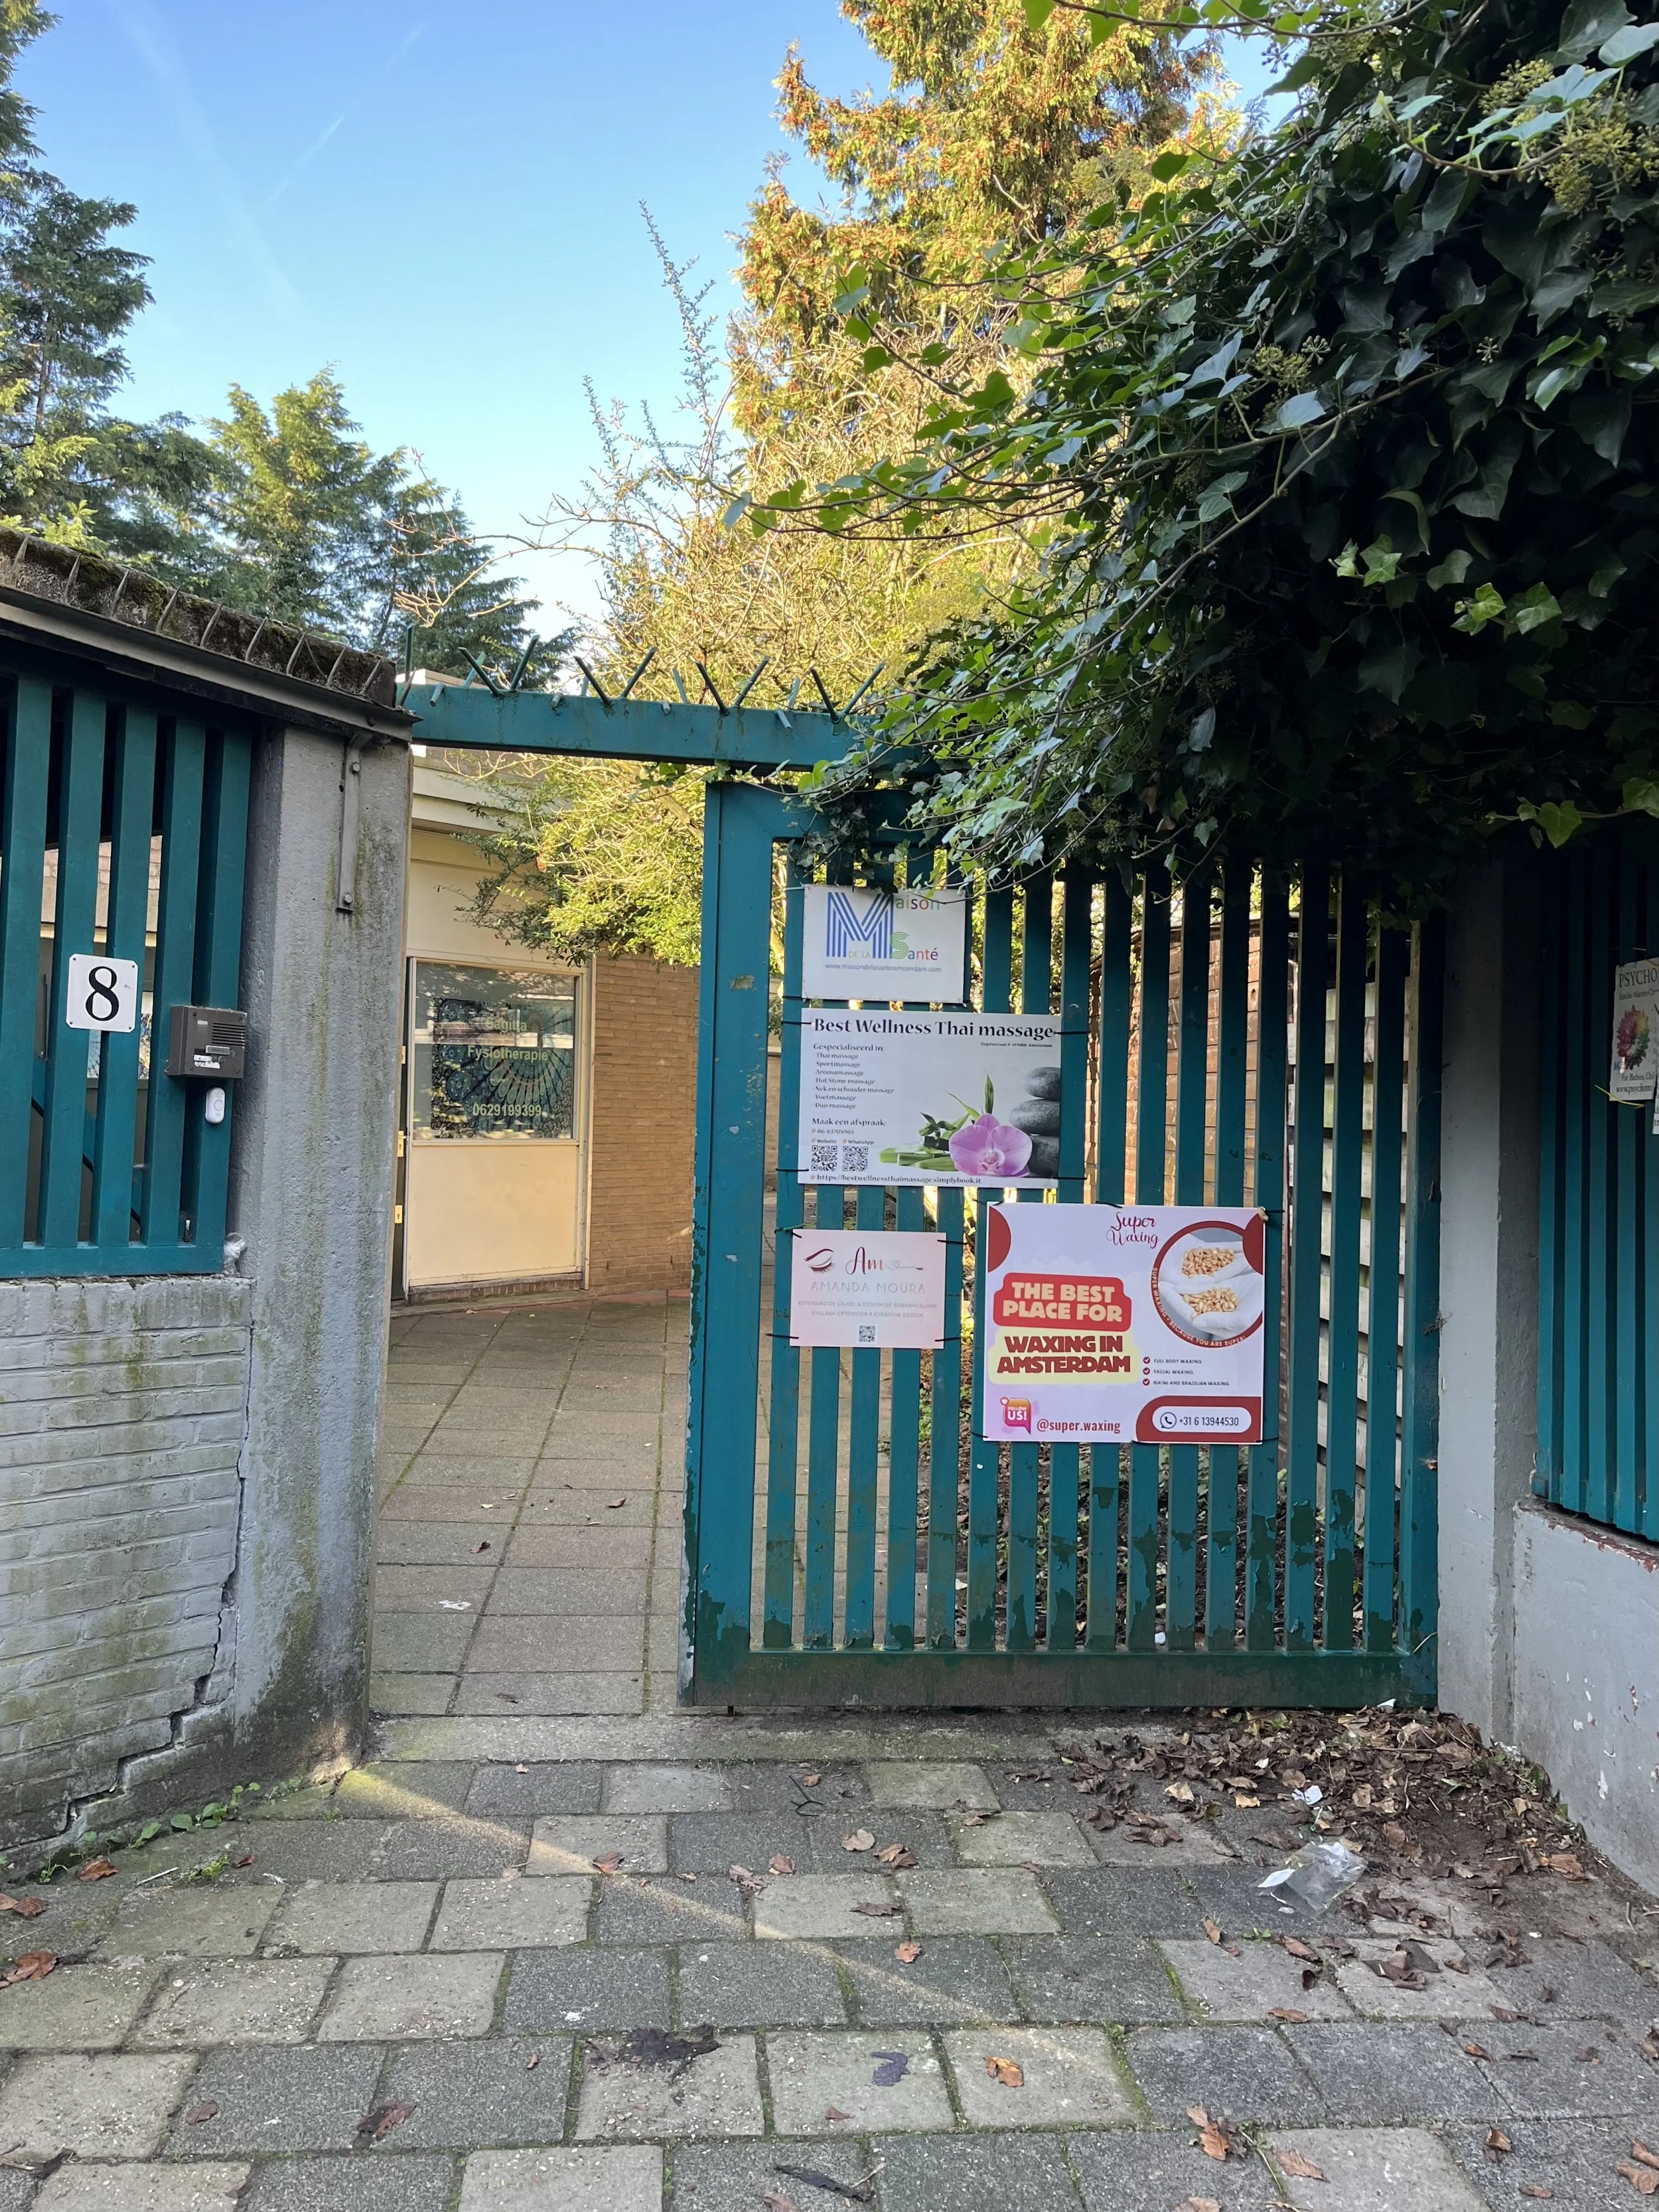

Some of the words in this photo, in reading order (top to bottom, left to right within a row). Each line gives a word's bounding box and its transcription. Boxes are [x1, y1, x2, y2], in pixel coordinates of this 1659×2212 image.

[891, 932, 939, 961] Santé
[1619, 968, 1659, 988] PSYCHO
[85, 966, 119, 1021] 8
[814, 1018, 852, 1033] Best
[855, 1019, 932, 1035] Wellness
[935, 1021, 974, 1036] Thai
[979, 1025, 1054, 1041] massage
[467, 1045, 549, 1063] Fysiotherapie
[814, 1043, 874, 1052] Gespecialiseerd
[472, 1102, 543, 1117] 0629199399
[1110, 1211, 1157, 1234] Super
[1106, 1229, 1158, 1249] Waxing
[845, 1246, 884, 1276] Am
[810, 1282, 870, 1293] AMANDA
[876, 1282, 926, 1294] MOURA
[1011, 1282, 1054, 1301] THE
[1060, 1284, 1116, 1303] BEST
[1003, 1299, 1071, 1320] PLACE
[1076, 1303, 1123, 1323] FOR
[1153, 1289, 1169, 1318] WAXING
[1169, 1321, 1194, 1341] BECAUSE
[1224, 1335, 1246, 1347] SUPER!
[1004, 1335, 1096, 1353] WAXING
[1100, 1335, 1123, 1353] IN
[997, 1355, 1131, 1373] AMSTERDAM
[1007, 1410, 1027, 1421] US!
[1179, 1416, 1192, 1426] +31
[1194, 1416, 1200, 1426] 6
[1201, 1416, 1239, 1427] 13944530
[1037, 1418, 1121, 1434] @super.waxing
